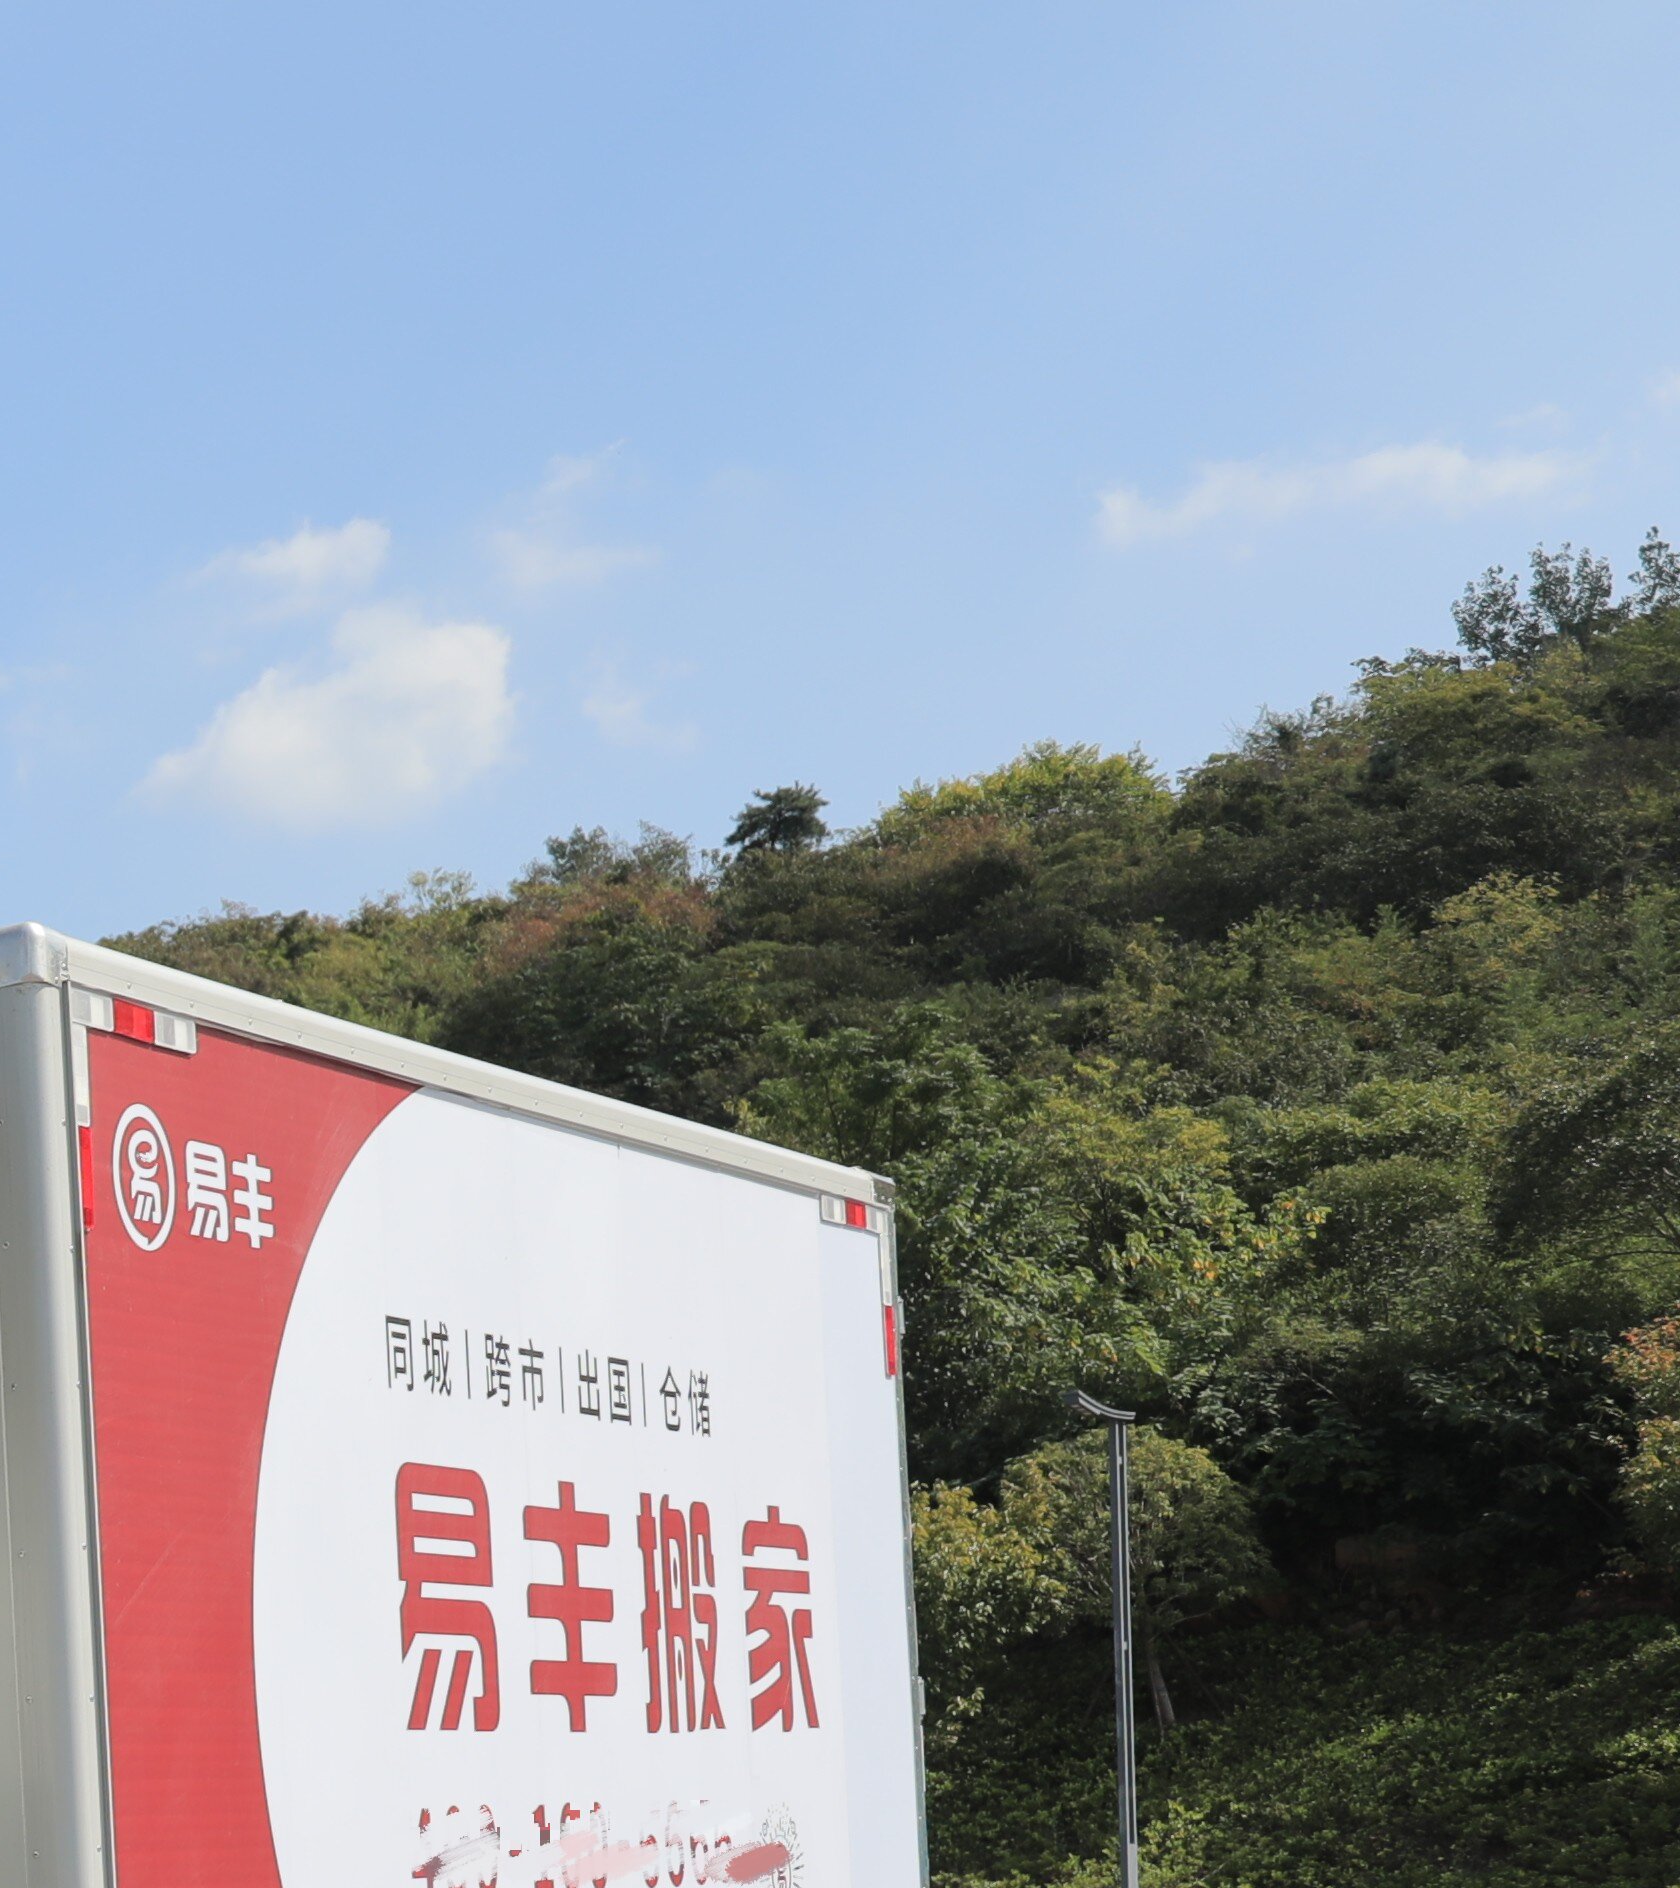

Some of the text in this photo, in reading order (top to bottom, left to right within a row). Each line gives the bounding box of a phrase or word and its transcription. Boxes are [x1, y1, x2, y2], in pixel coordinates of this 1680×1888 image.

[185, 1140, 275, 1249] 易丰
[395, 1462, 820, 1733] 易丰搬家
